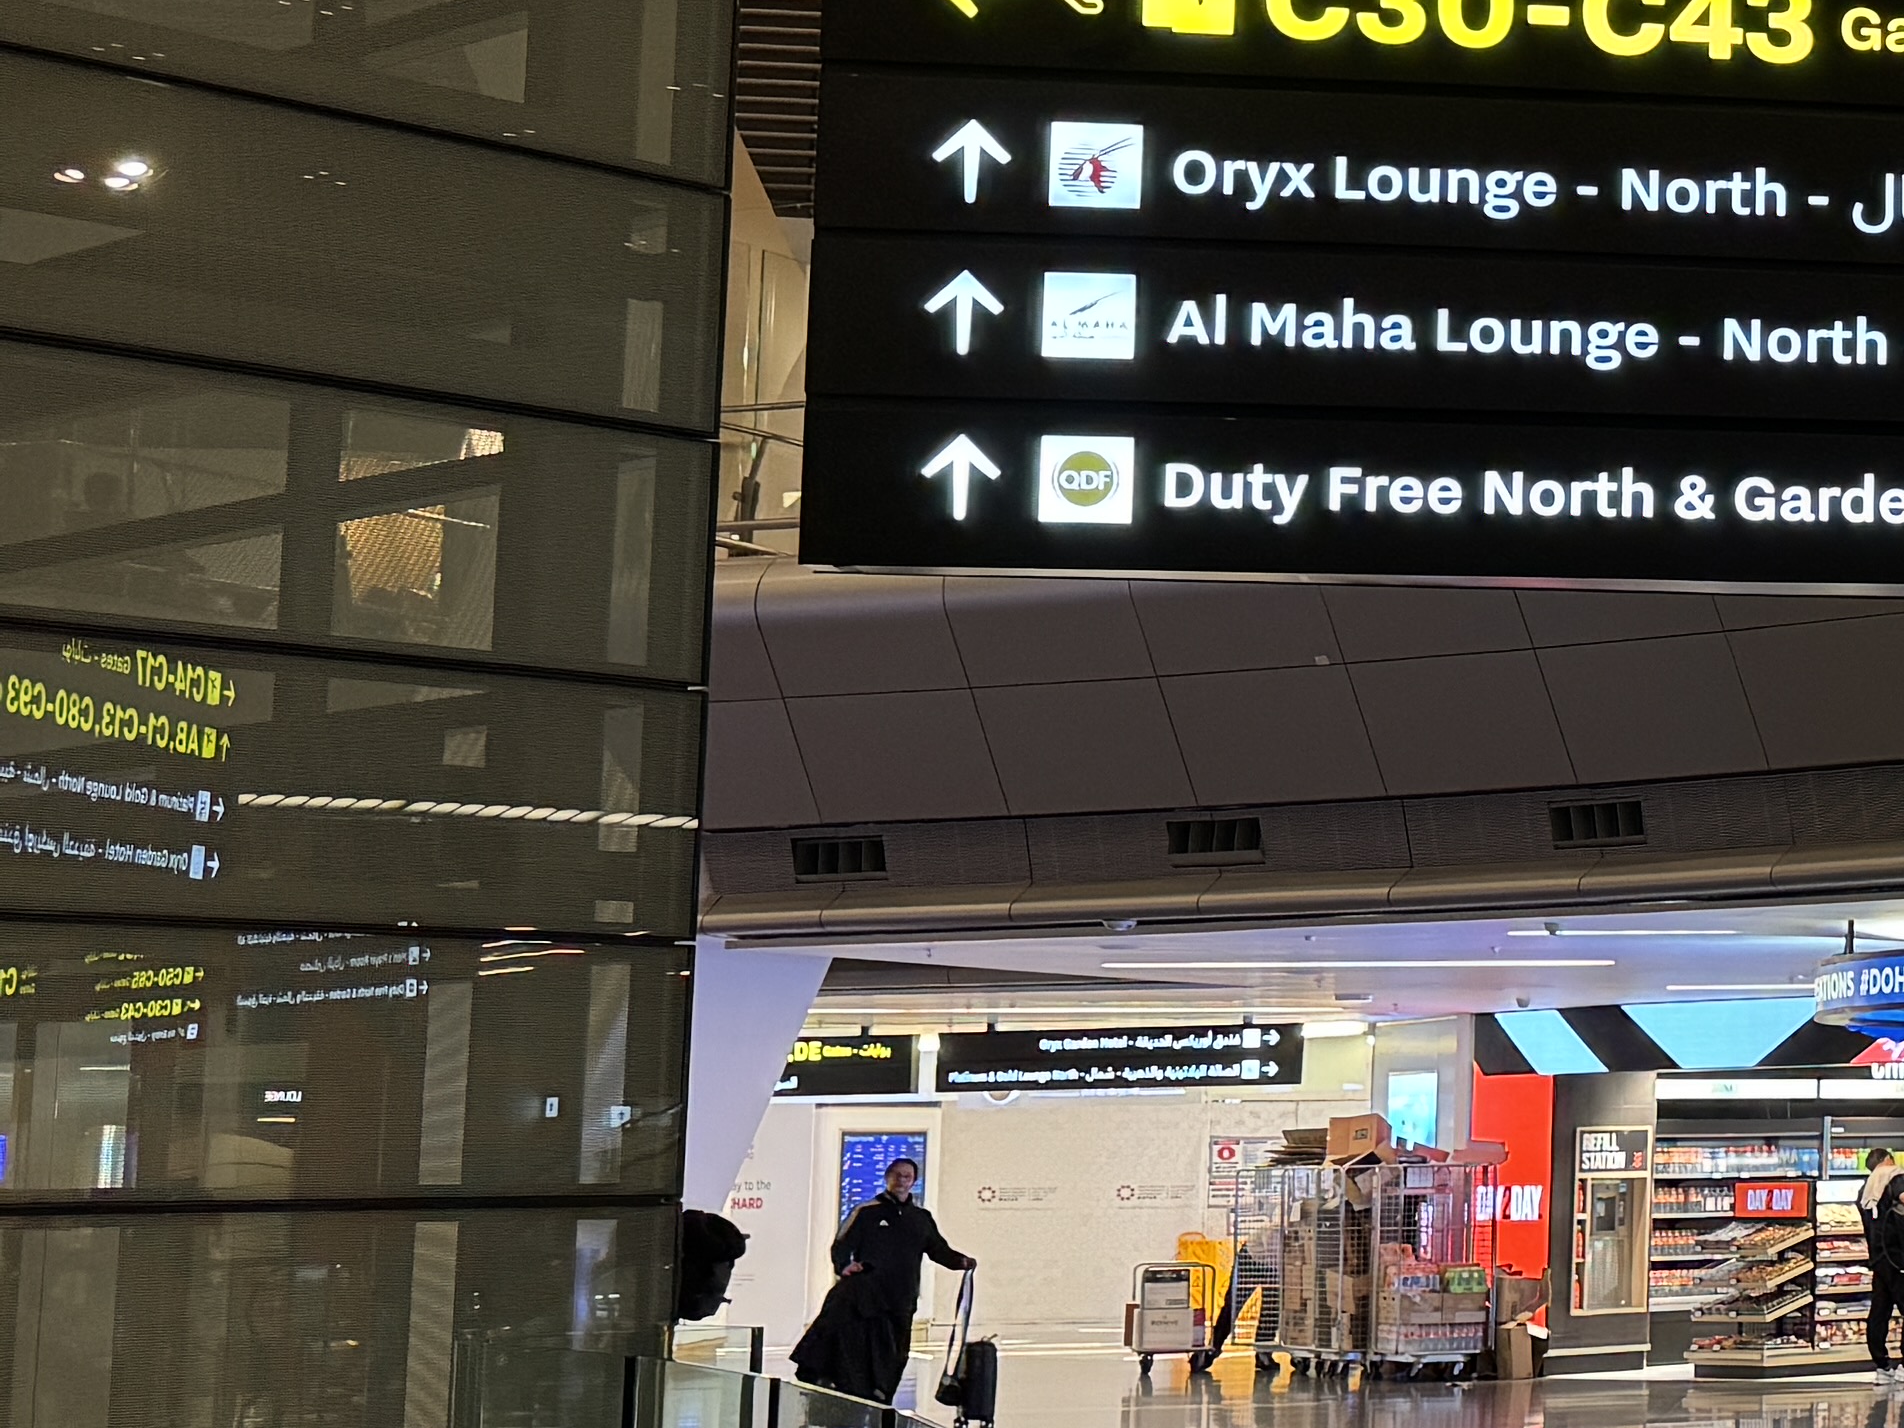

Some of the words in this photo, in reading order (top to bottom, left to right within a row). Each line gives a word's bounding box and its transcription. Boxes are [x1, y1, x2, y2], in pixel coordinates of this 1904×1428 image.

[1171, 148, 1317, 212] Oryx
[1333, 154, 1559, 221] Lounge
[1620, 165, 1788, 219] North
[1164, 292, 1228, 347] Al
[1248, 296, 1418, 353] Maha
[1435, 306, 1661, 373] Lounge
[1721, 314, 1889, 367] North
[1058, 470, 1112, 491] QDF
[1161, 461, 1311, 527] Duty
[1326, 465, 1464, 516] Free
[1482, 465, 1656, 520] North
[1672, 473, 1717, 522] &
[1581, 1151, 1627, 1170] STATION
[744, 1180, 754, 1191] to
[757, 1179, 771, 1191] the
